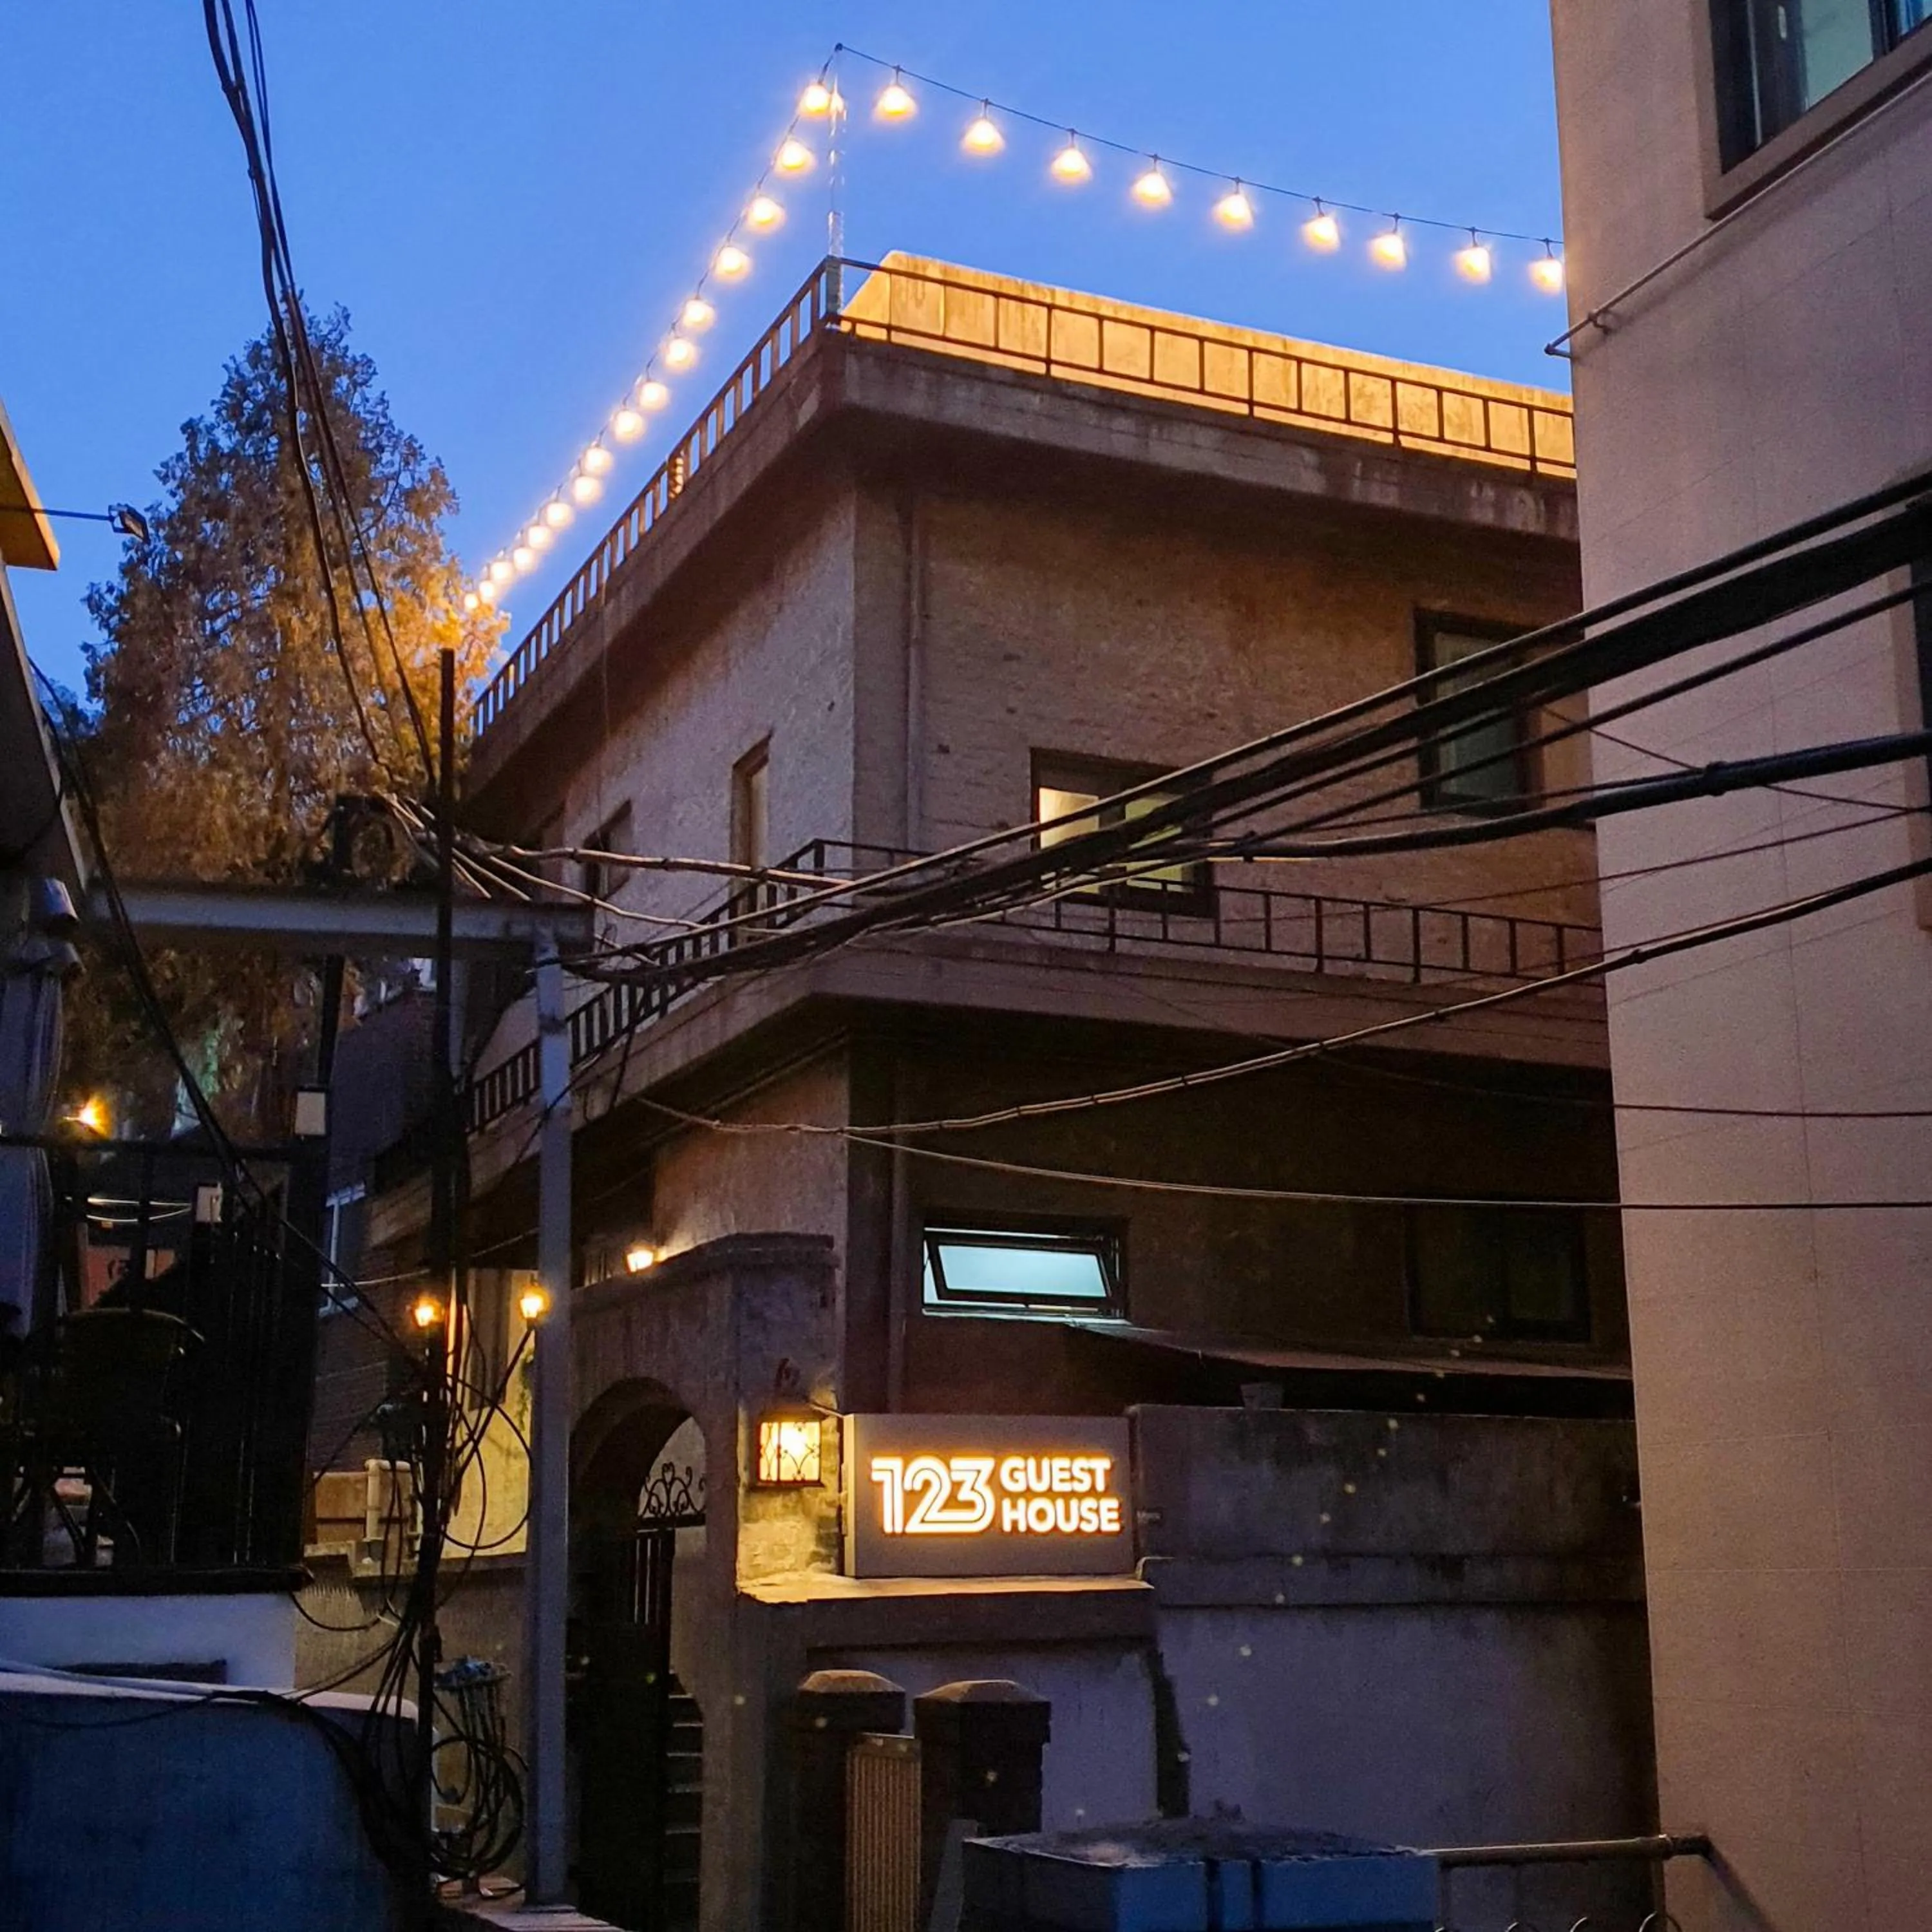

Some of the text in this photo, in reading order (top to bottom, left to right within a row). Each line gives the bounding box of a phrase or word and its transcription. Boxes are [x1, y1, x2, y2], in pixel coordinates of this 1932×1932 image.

[999, 1457, 1110, 1492] GUEST
[871, 1457, 995, 1533] 123
[1001, 1497, 1121, 1532] HOUSE
